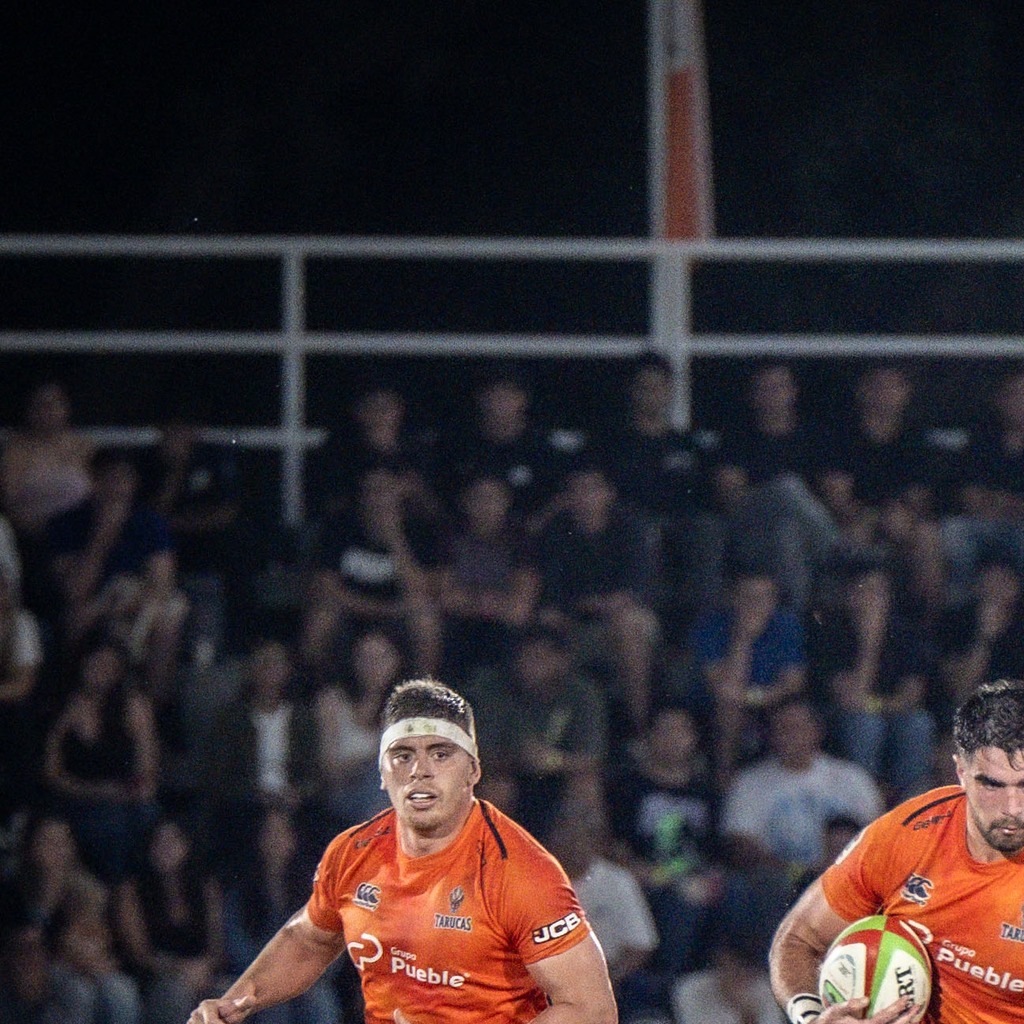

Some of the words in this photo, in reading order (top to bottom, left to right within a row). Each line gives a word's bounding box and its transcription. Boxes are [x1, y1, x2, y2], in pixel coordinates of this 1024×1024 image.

[434, 914, 472, 931] TARUCAS
[533, 911, 582, 943] JCB
[390, 946, 417, 961] Grupo
[942, 939, 976, 958] Grupo
[391, 957, 466, 988] Pueble
